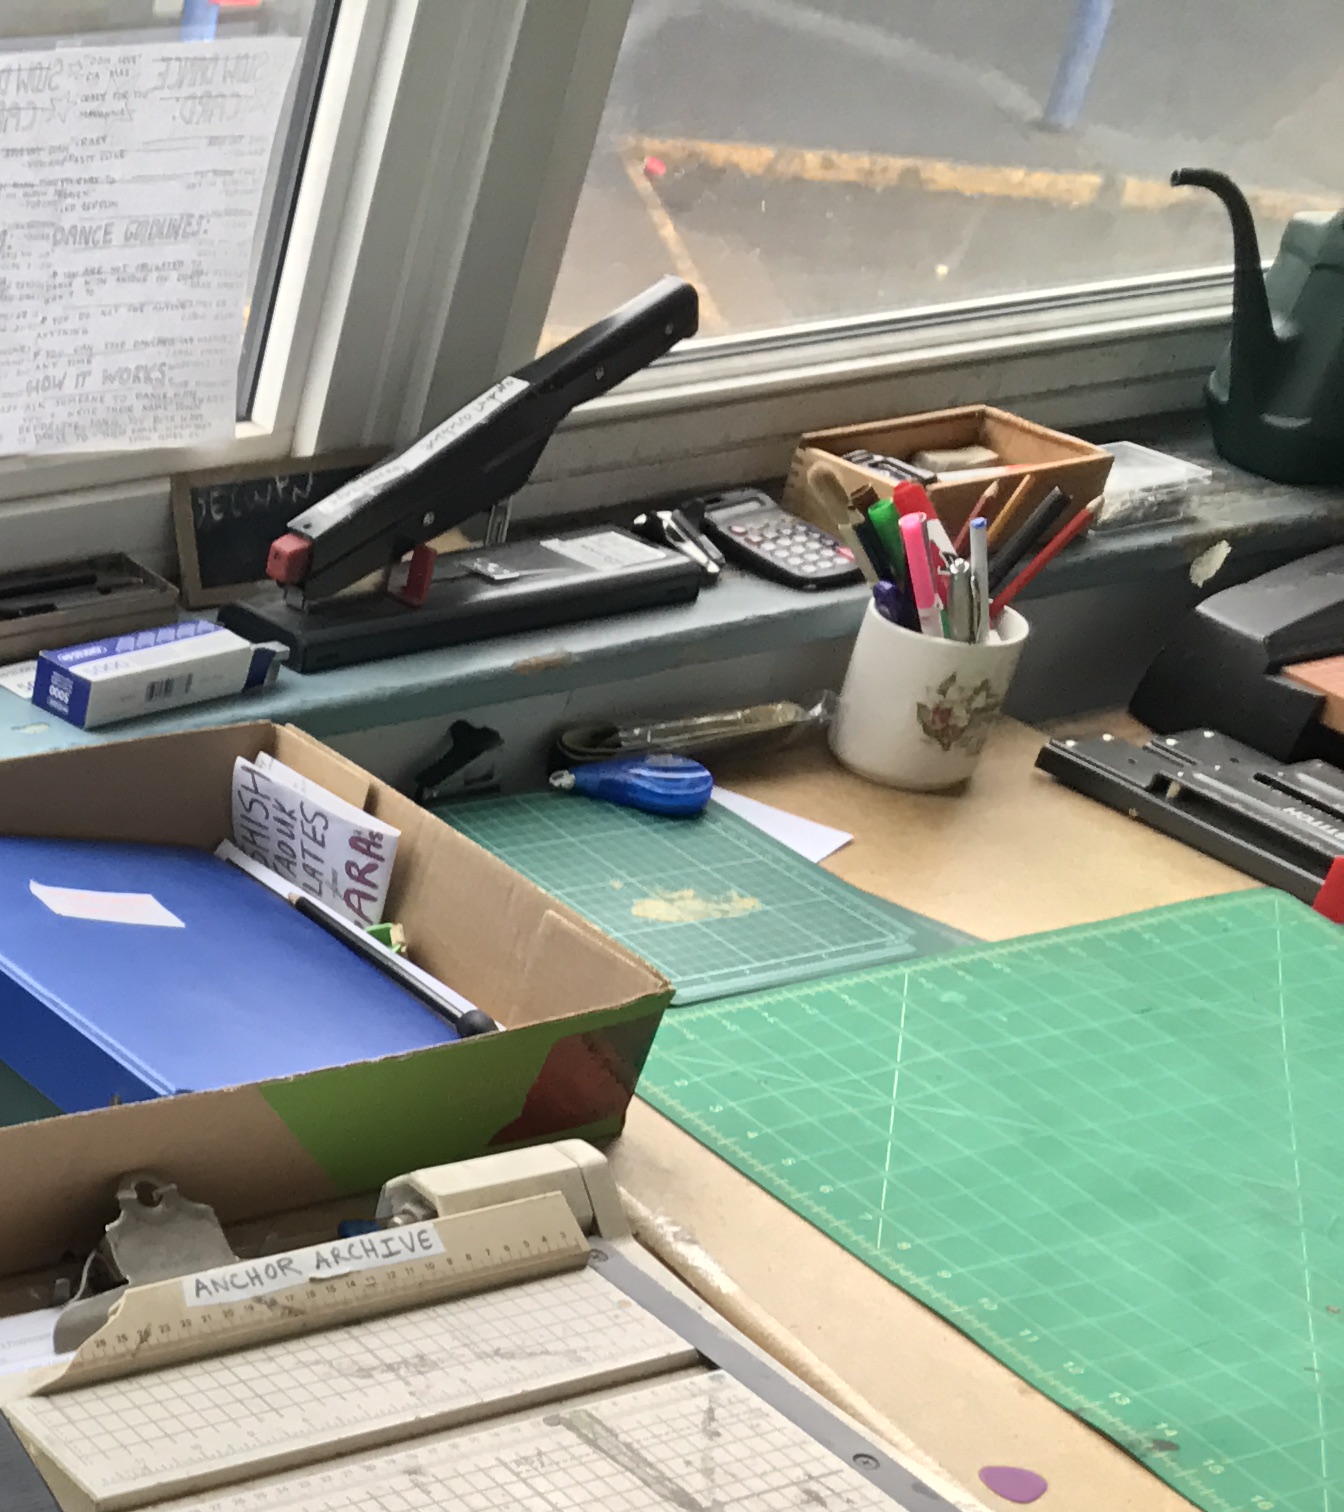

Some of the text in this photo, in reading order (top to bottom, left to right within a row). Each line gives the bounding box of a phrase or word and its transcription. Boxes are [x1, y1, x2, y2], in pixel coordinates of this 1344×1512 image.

[74, 369, 93, 389] IT
[194, 1230, 434, 1299] ANCHOR ARCHIVE
